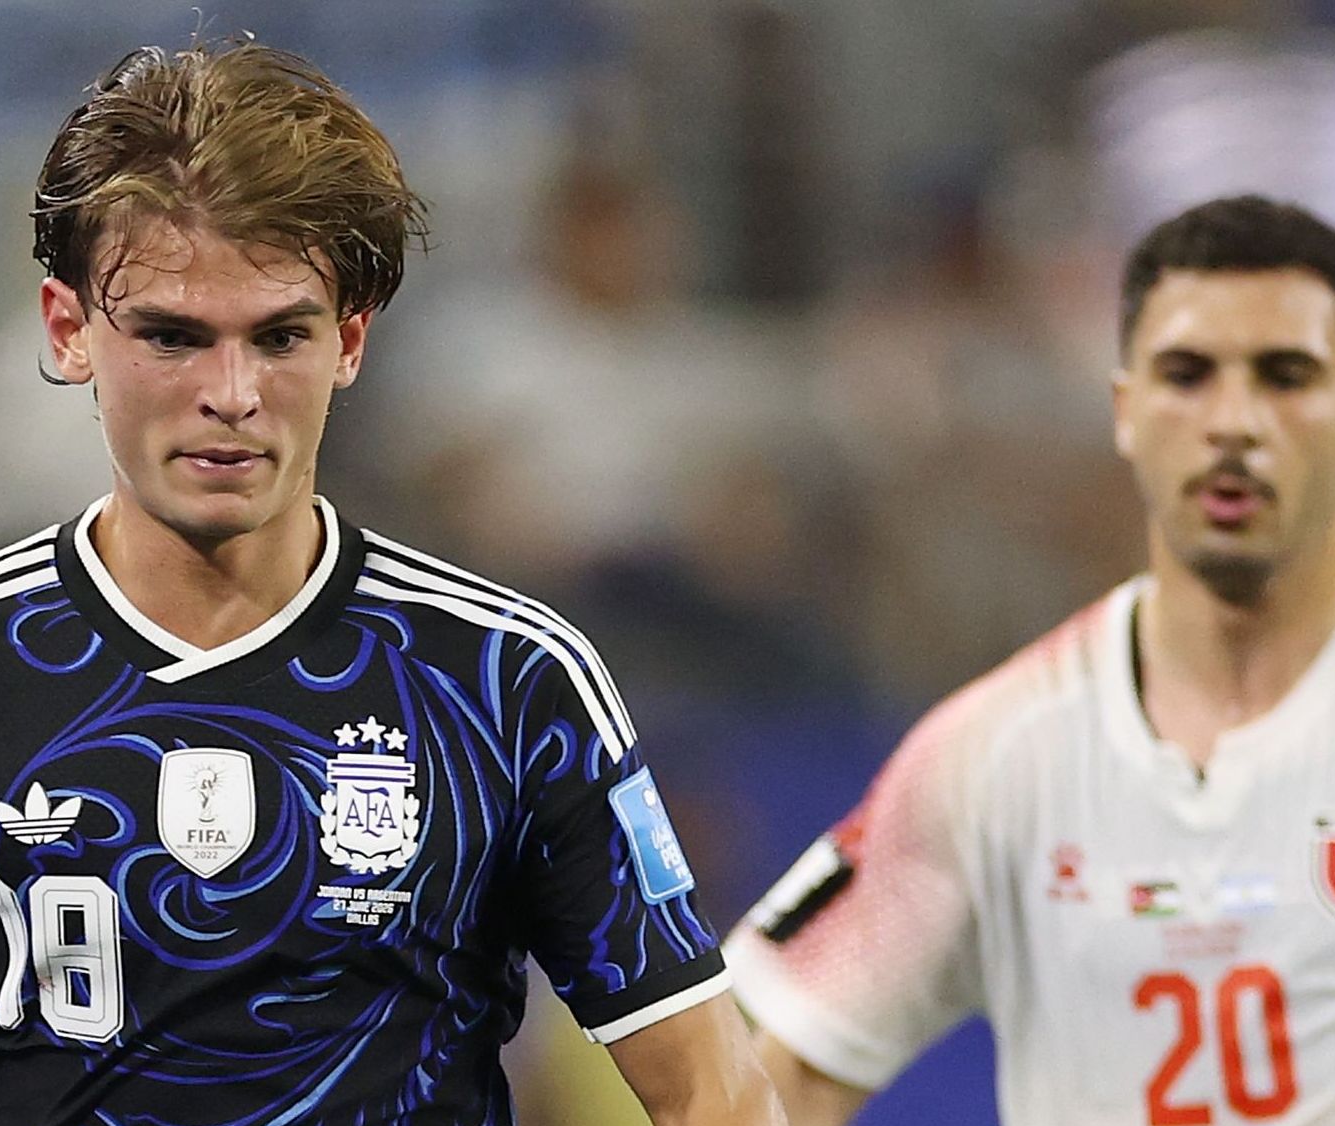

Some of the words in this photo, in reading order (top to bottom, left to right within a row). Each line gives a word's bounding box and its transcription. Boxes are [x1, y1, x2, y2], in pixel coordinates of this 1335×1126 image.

[342, 784, 397, 838] AFA
[187, 829, 227, 843] FIFA
[193, 851, 218, 859] 2022
[333, 899, 346, 911] 27
